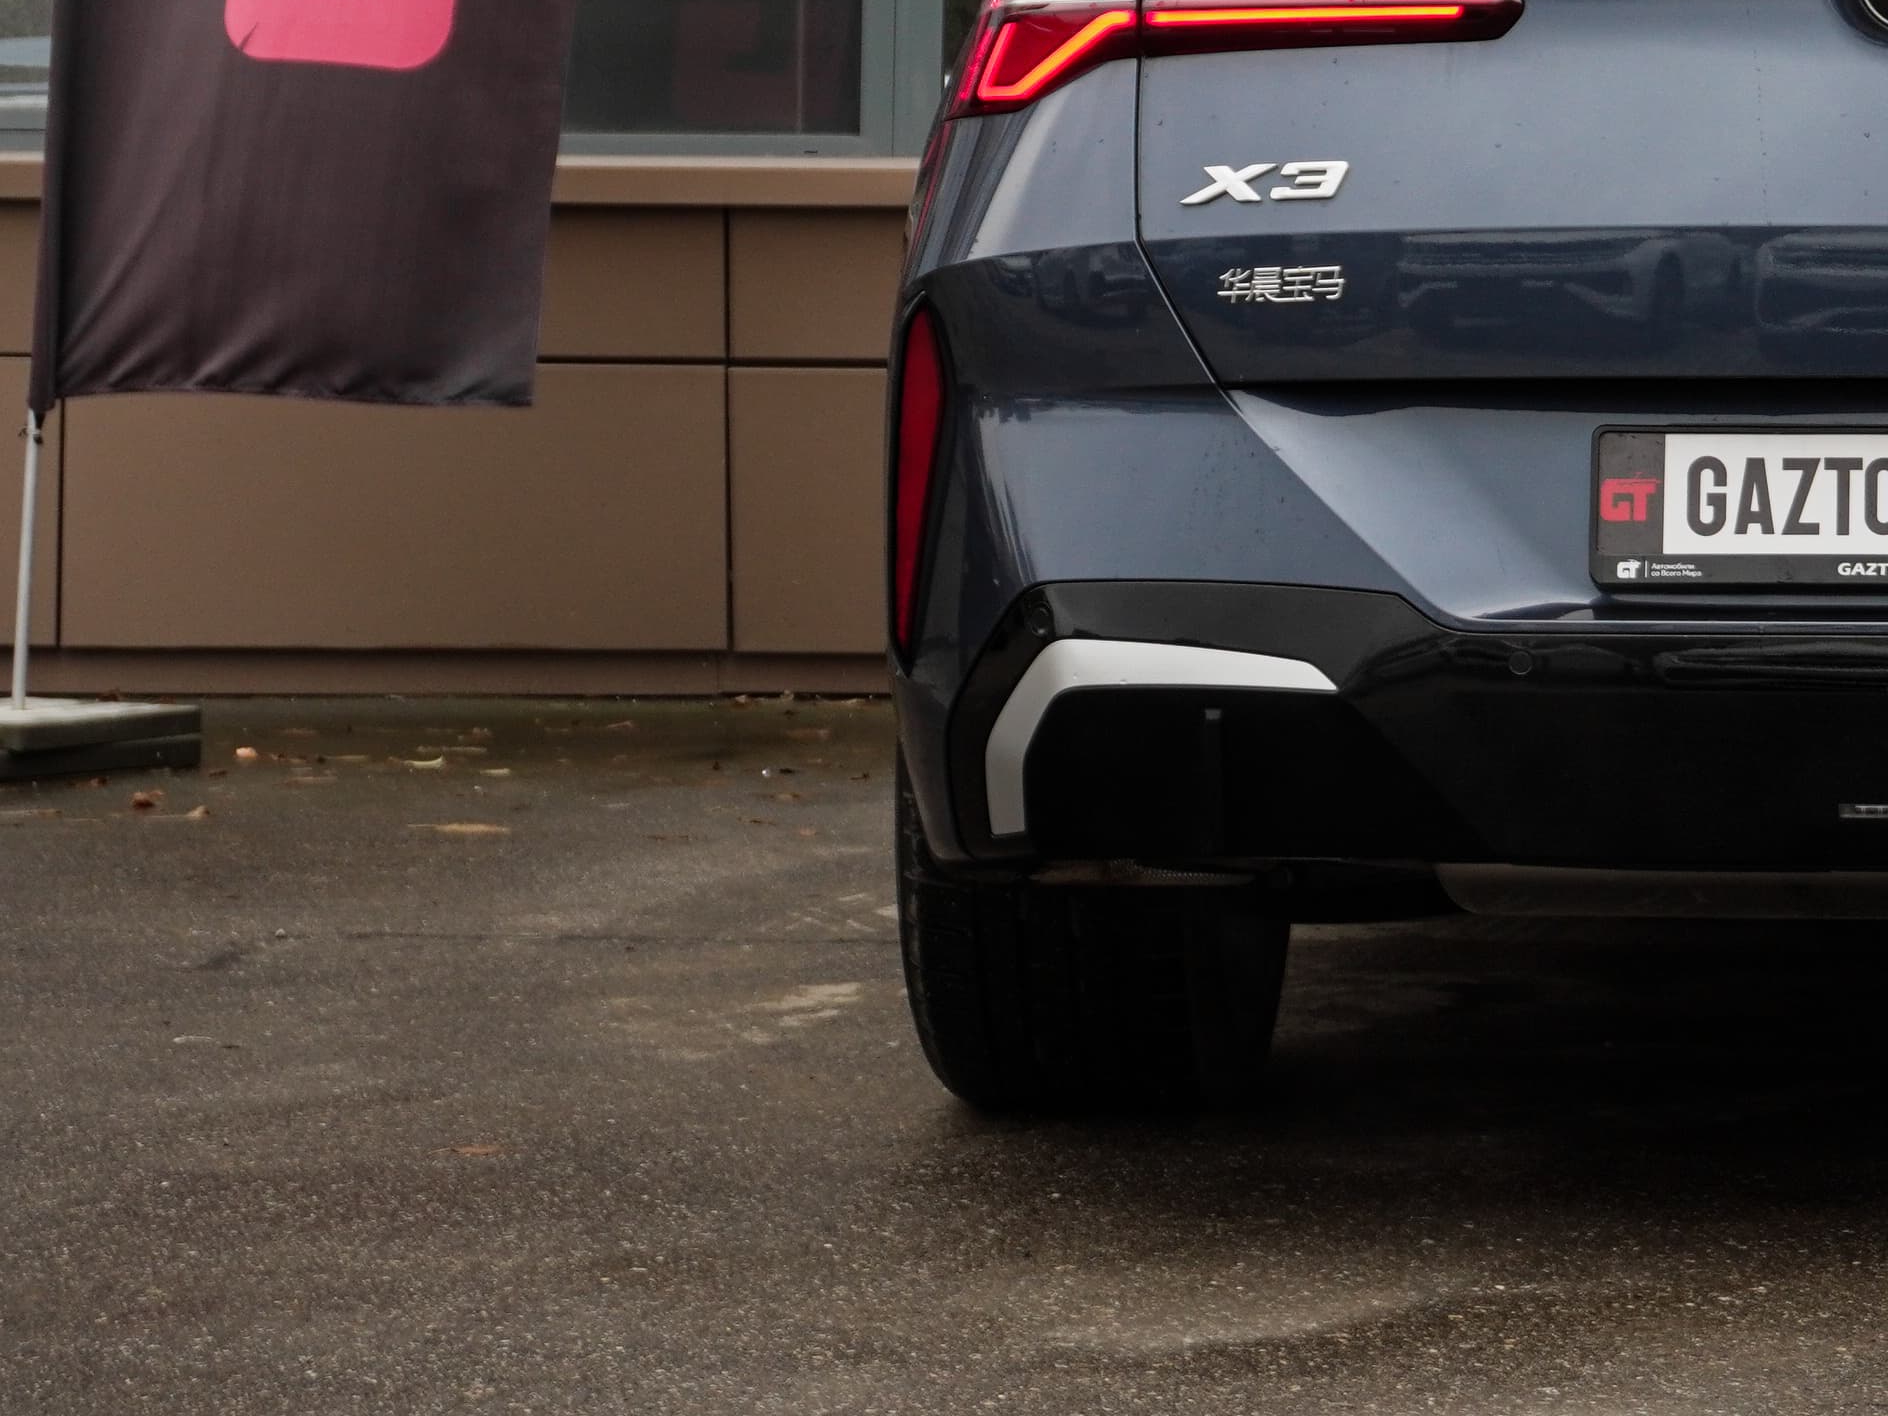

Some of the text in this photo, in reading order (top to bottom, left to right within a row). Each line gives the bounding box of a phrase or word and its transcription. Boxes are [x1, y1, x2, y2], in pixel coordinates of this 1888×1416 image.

[1178, 160, 1350, 205] X3
[1217, 265, 1346, 304] 华晨宝马
